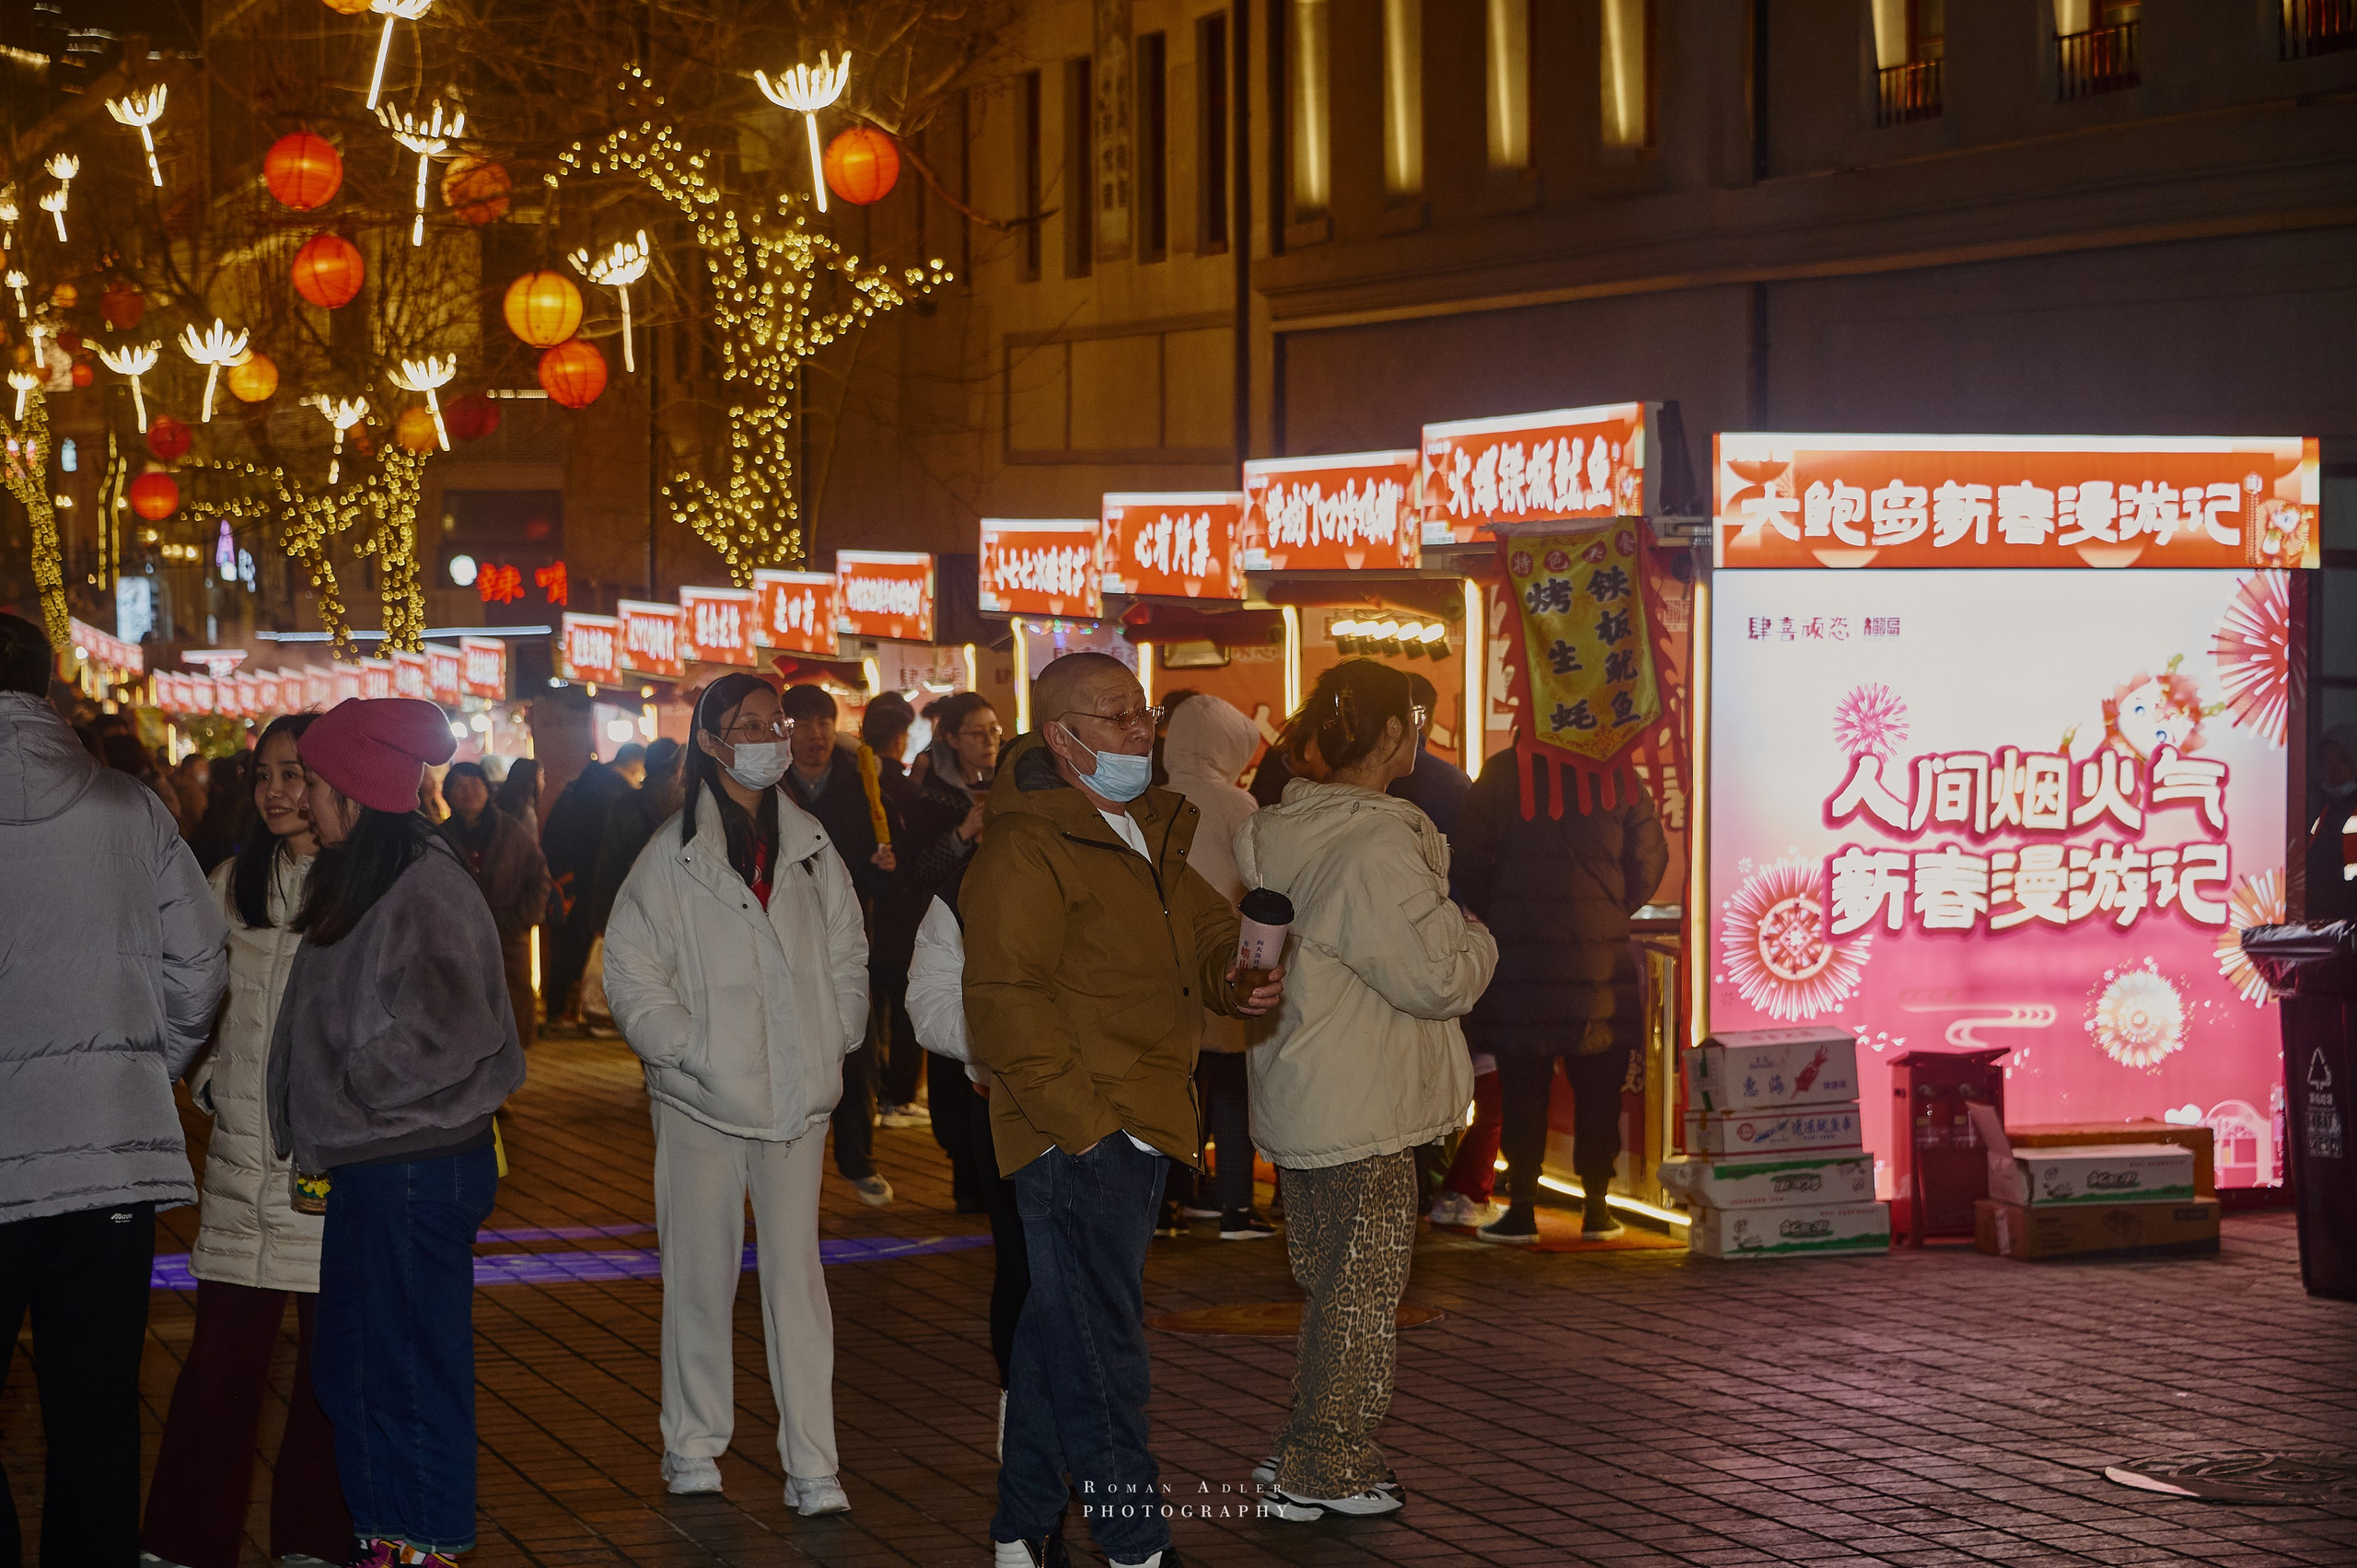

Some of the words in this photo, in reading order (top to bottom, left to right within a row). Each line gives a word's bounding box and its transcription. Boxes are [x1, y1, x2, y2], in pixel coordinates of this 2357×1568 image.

[1740, 479, 2240, 547] 大鲍岛新春漫游记
[1526, 577, 1597, 732] 烤生蚝
[1585, 565, 1641, 728] 铁板鱿鱼
[1830, 746, 2226, 834] 人间烟火气
[1830, 842, 2228, 935] 新春漫游记
